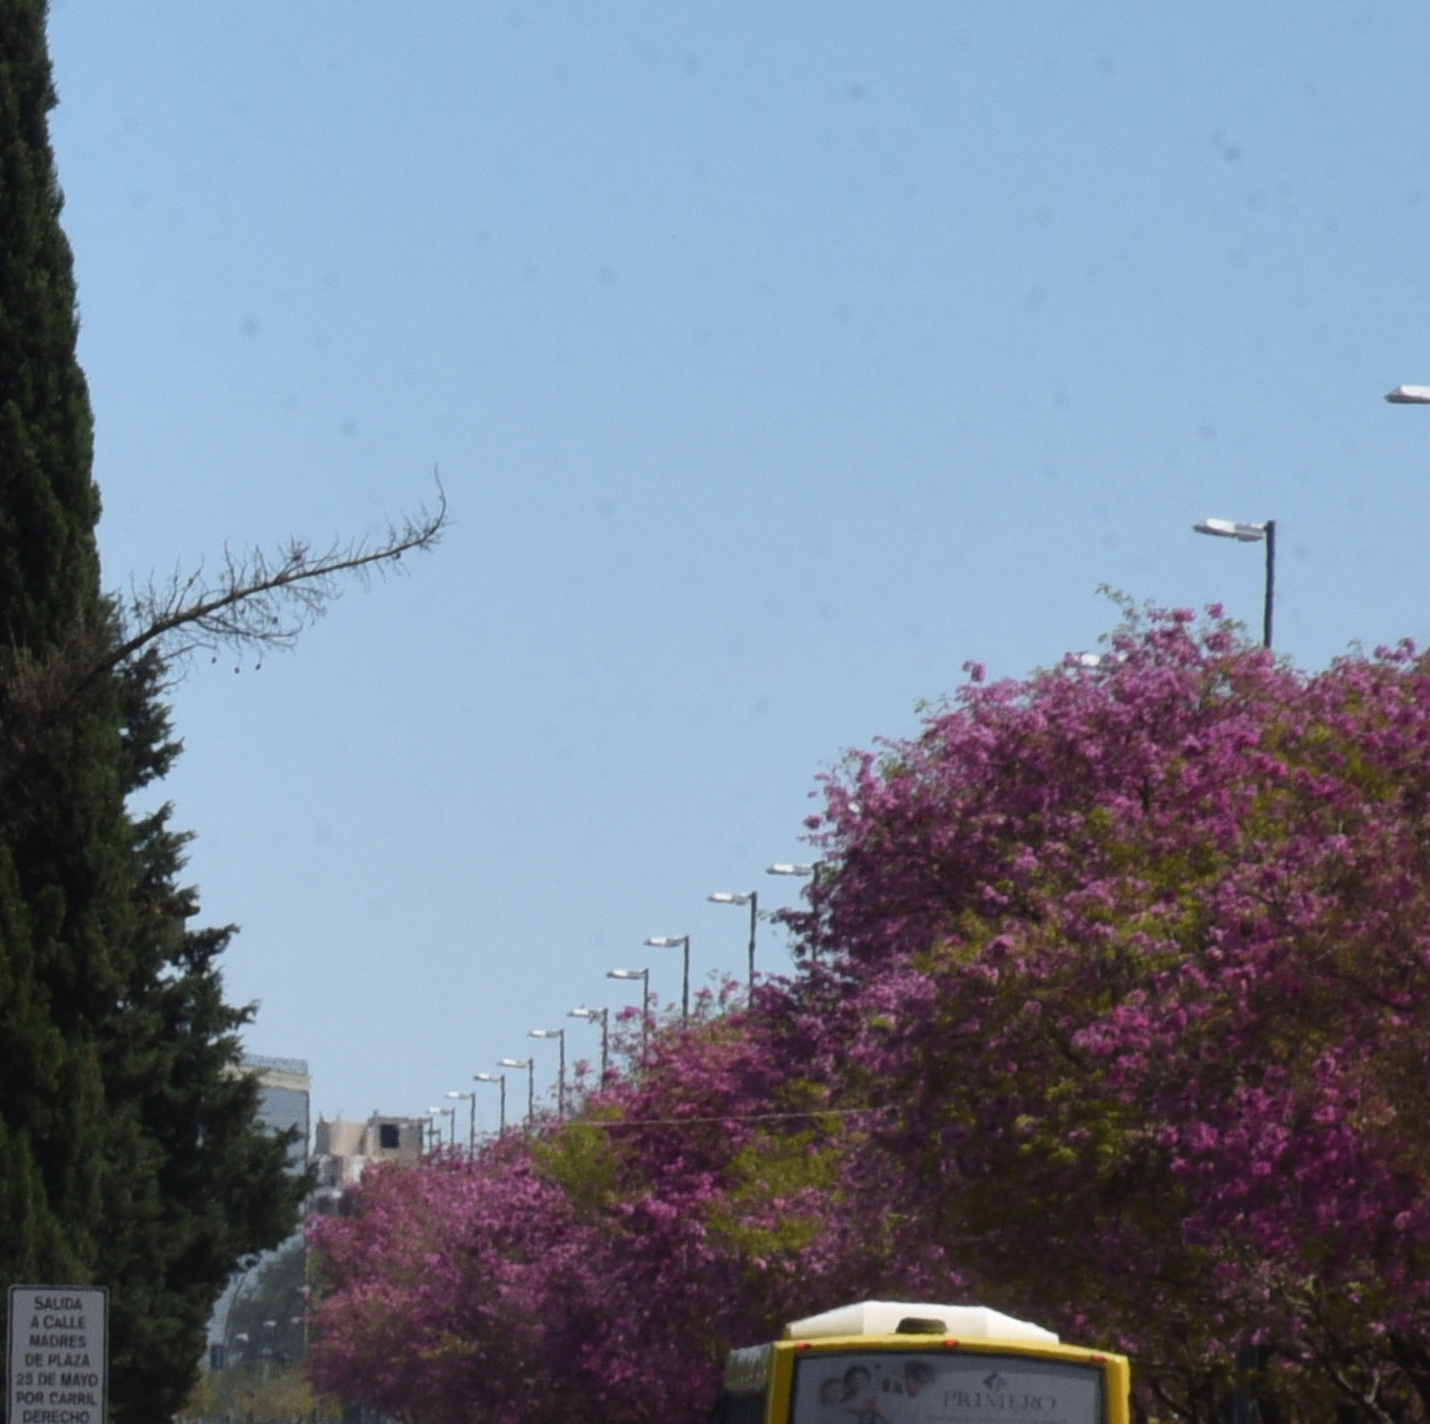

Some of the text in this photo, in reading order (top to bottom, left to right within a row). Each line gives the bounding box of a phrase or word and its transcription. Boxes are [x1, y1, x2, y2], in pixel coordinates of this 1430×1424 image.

[34, 1296, 82, 1310] SALIDA
[30, 1315, 85, 1329] A CALLE
[29, 1334, 87, 1348] MADRES
[25, 1353, 90, 1367] DE PLAZA
[16, 1372, 98, 1387] 25 DE MAYO
[16, 1391, 97, 1406] POR CARRIL
[942, 1391, 1059, 1410] PRIMERO
[23, 1409, 90, 1424] DERECHO
